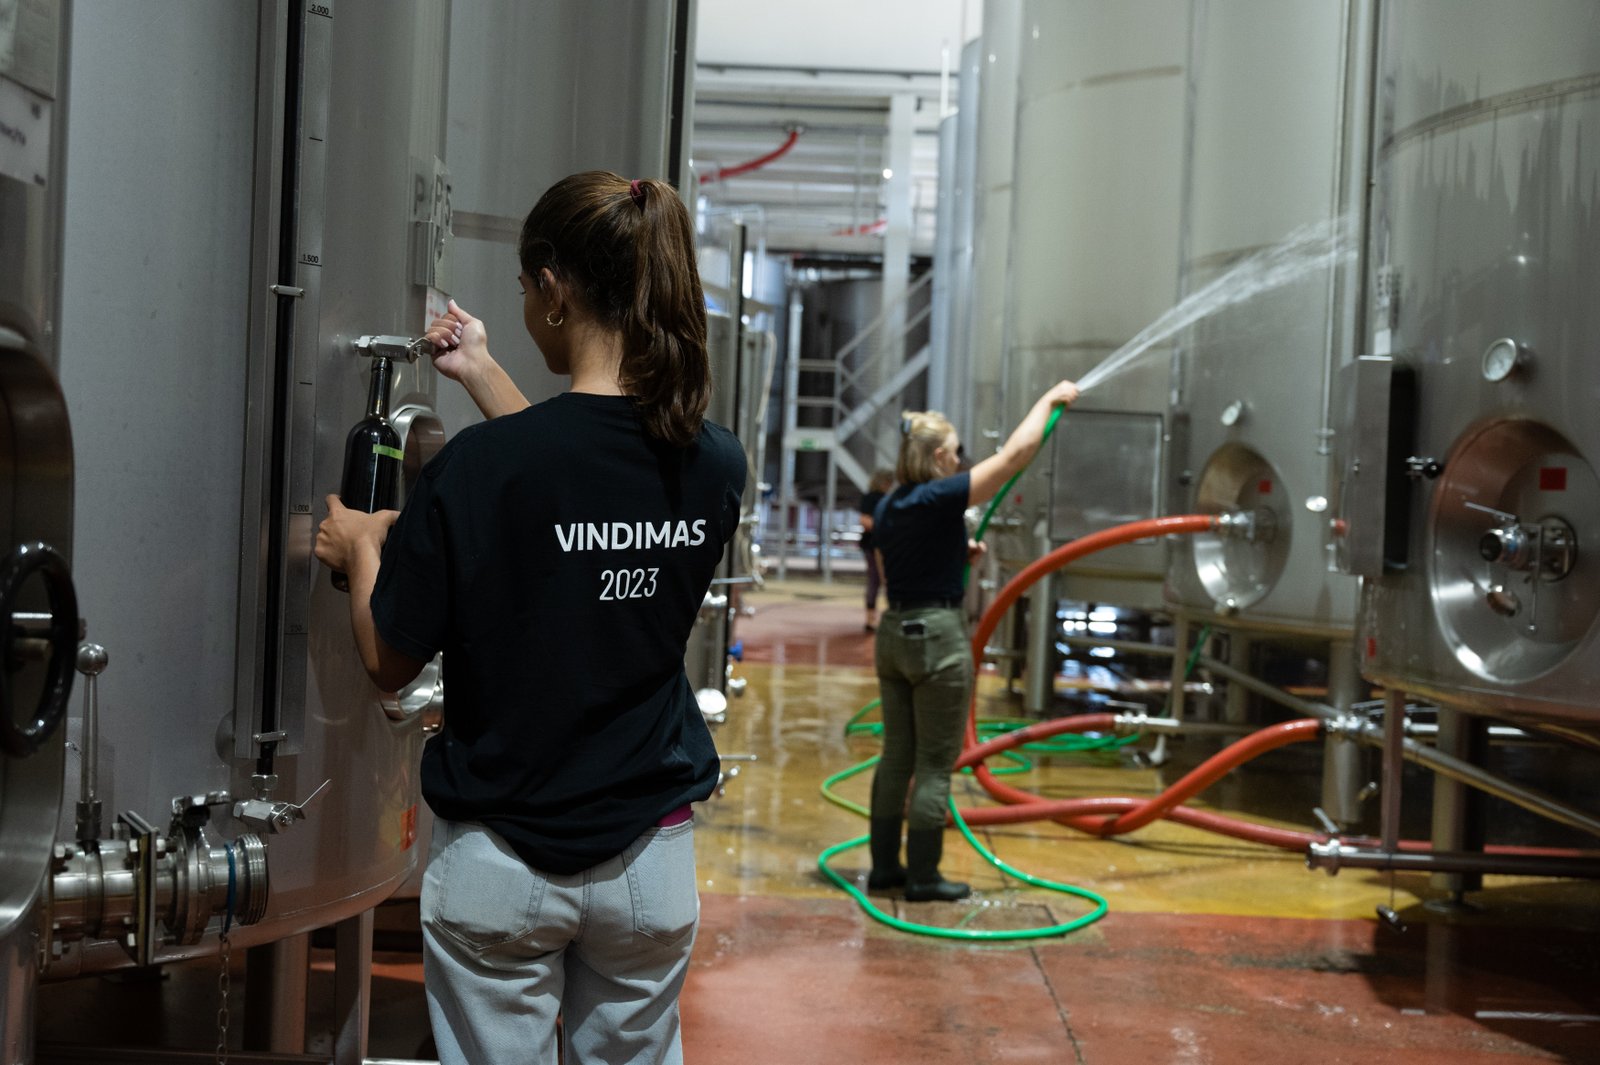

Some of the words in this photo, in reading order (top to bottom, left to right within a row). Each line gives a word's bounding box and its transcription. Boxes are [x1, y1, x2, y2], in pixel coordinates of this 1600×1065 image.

[312, 4, 329, 16] 2.000
[303, 253, 319, 264] 1.500
[554, 519, 706, 552] VINDIMAS
[599, 568, 660, 601] 2023
